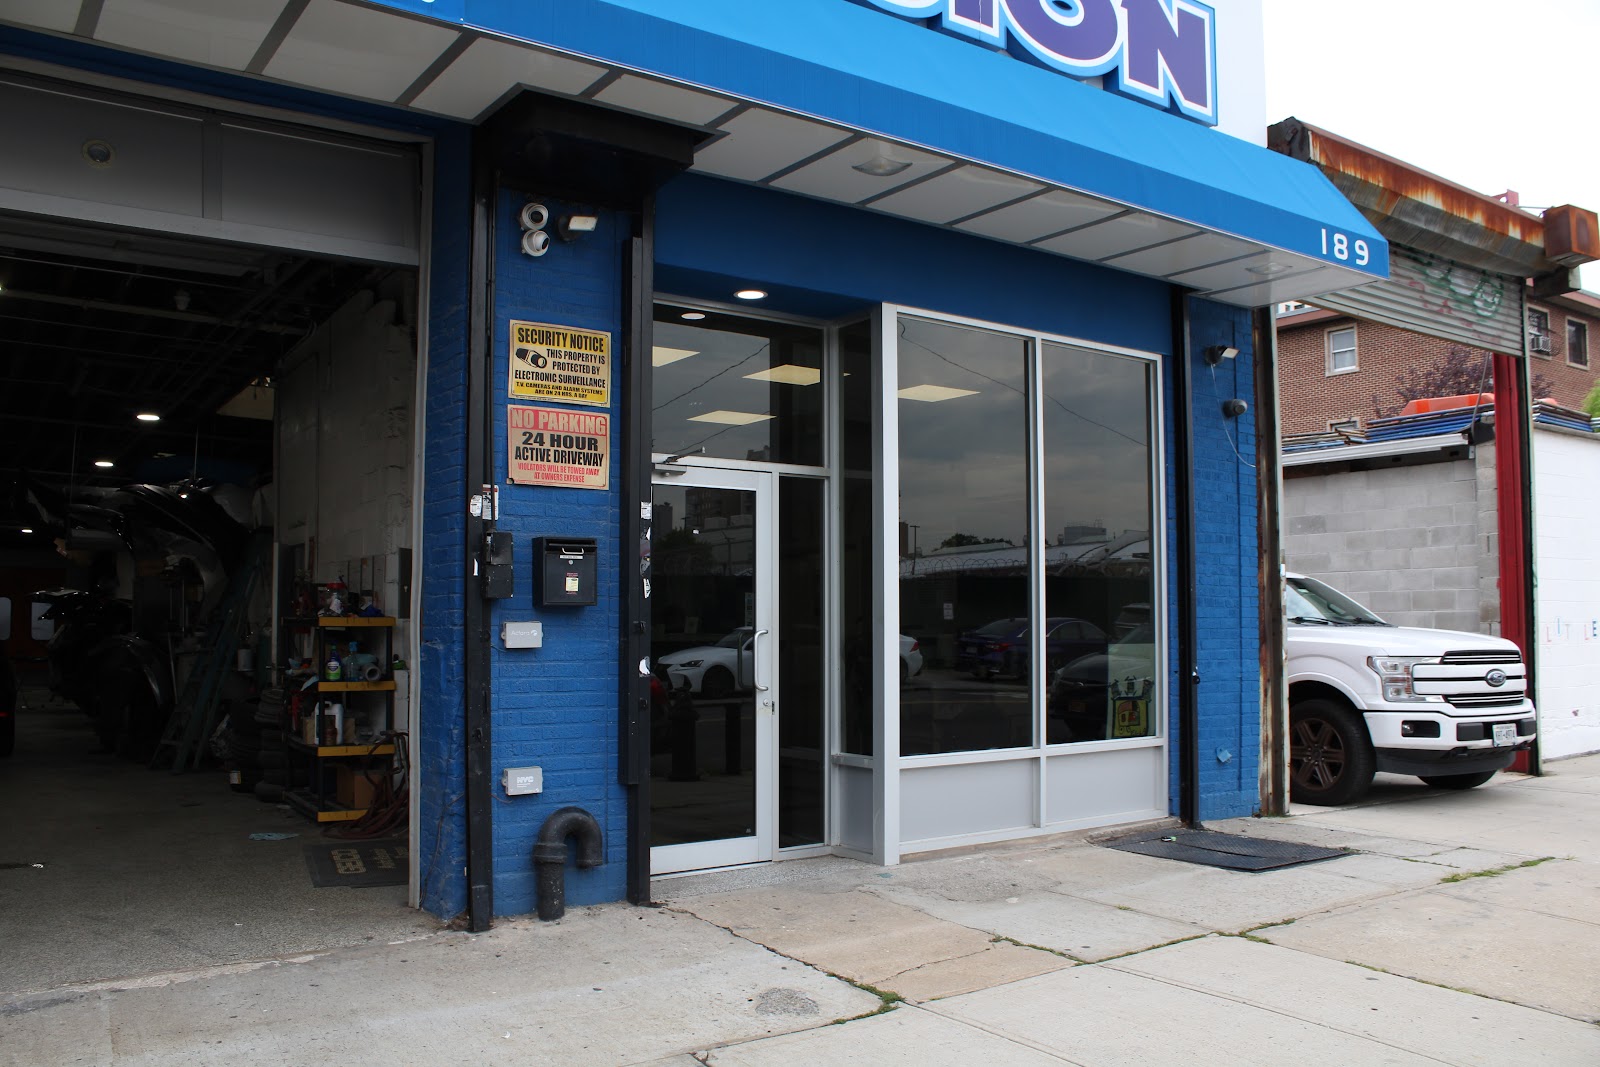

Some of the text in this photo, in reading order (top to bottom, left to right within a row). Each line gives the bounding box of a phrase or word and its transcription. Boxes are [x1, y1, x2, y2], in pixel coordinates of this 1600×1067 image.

[1321, 228, 1369, 266] 189
[517, 328, 604, 353] SECURITY NOTICE
[546, 348, 605, 365] THIS PROPERTY IS
[552, 360, 600, 375] PROTECTED BY
[514, 369, 606, 389] ELECTRONIC SURVEILLANCE
[525, 382, 551, 390] CAMERAS
[580, 387, 603, 396] SYSTEMS
[511, 409, 606, 435] NO PARKING
[522, 431, 598, 451] 24 HOUR
[514, 446, 604, 467] ACTIVE DRIVEWAY
[517, 462, 600, 476] VIOLATORS WILL BE TOWED AWAY
[541, 472, 562, 481] OWNERS
[563, 474, 585, 483] EXPENSE
[516, 776, 534, 784] NYC
